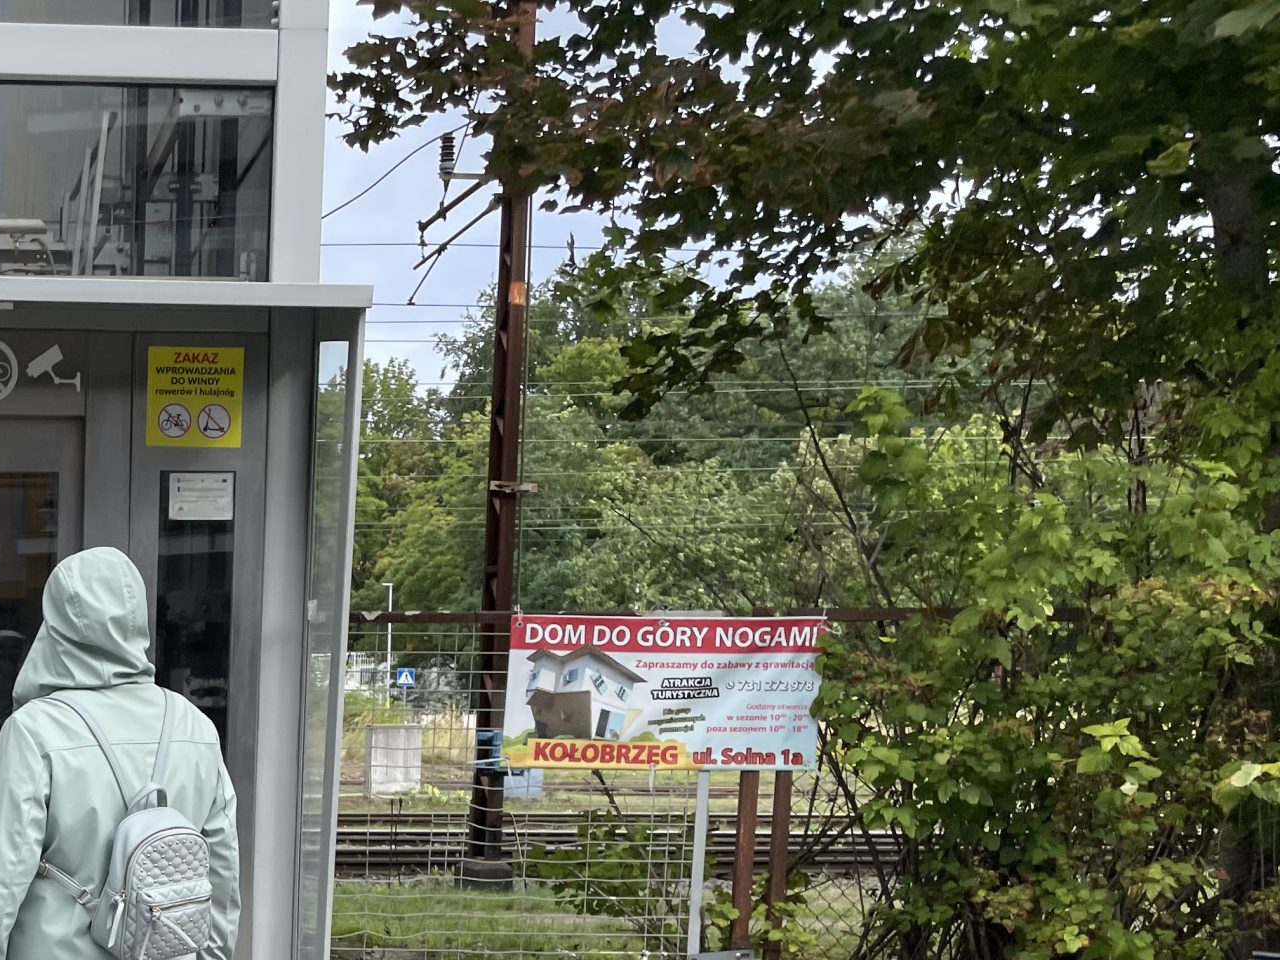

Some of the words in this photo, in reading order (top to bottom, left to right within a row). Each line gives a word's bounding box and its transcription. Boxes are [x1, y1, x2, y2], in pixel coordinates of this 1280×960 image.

[173, 352, 220, 364] ZAKAZ
[155, 366, 236, 375] WPROWADZANIA
[170, 376, 186, 385] DO
[188, 377, 221, 386] WINDY
[155, 387, 193, 395] rowerów
[199, 387, 235, 397] hulajnóg
[524, 623, 586, 645] DOM
[592, 625, 631, 646] DO
[636, 621, 710, 647] GÓRY
[715, 626, 818, 648] NOGAMI
[635, 660, 698, 671] Zapraszamy
[700, 660, 715, 669] do
[716, 660, 753, 671] zabawy
[662, 678, 711, 688] ATRAKCJA
[737, 680, 762, 692] 731
[764, 680, 789, 692] 272
[790, 680, 814, 692] 978
[652, 688, 719, 700] TURYSTYCZNA
[736, 713, 768, 721] sezonie
[706, 725, 727, 733] poza
[729, 725, 767, 733] sezonem
[534, 741, 679, 765] KOŁOBRZEG
[692, 747, 717, 765] ul.
[721, 747, 776, 766] Solna
[781, 748, 804, 766] 1a
